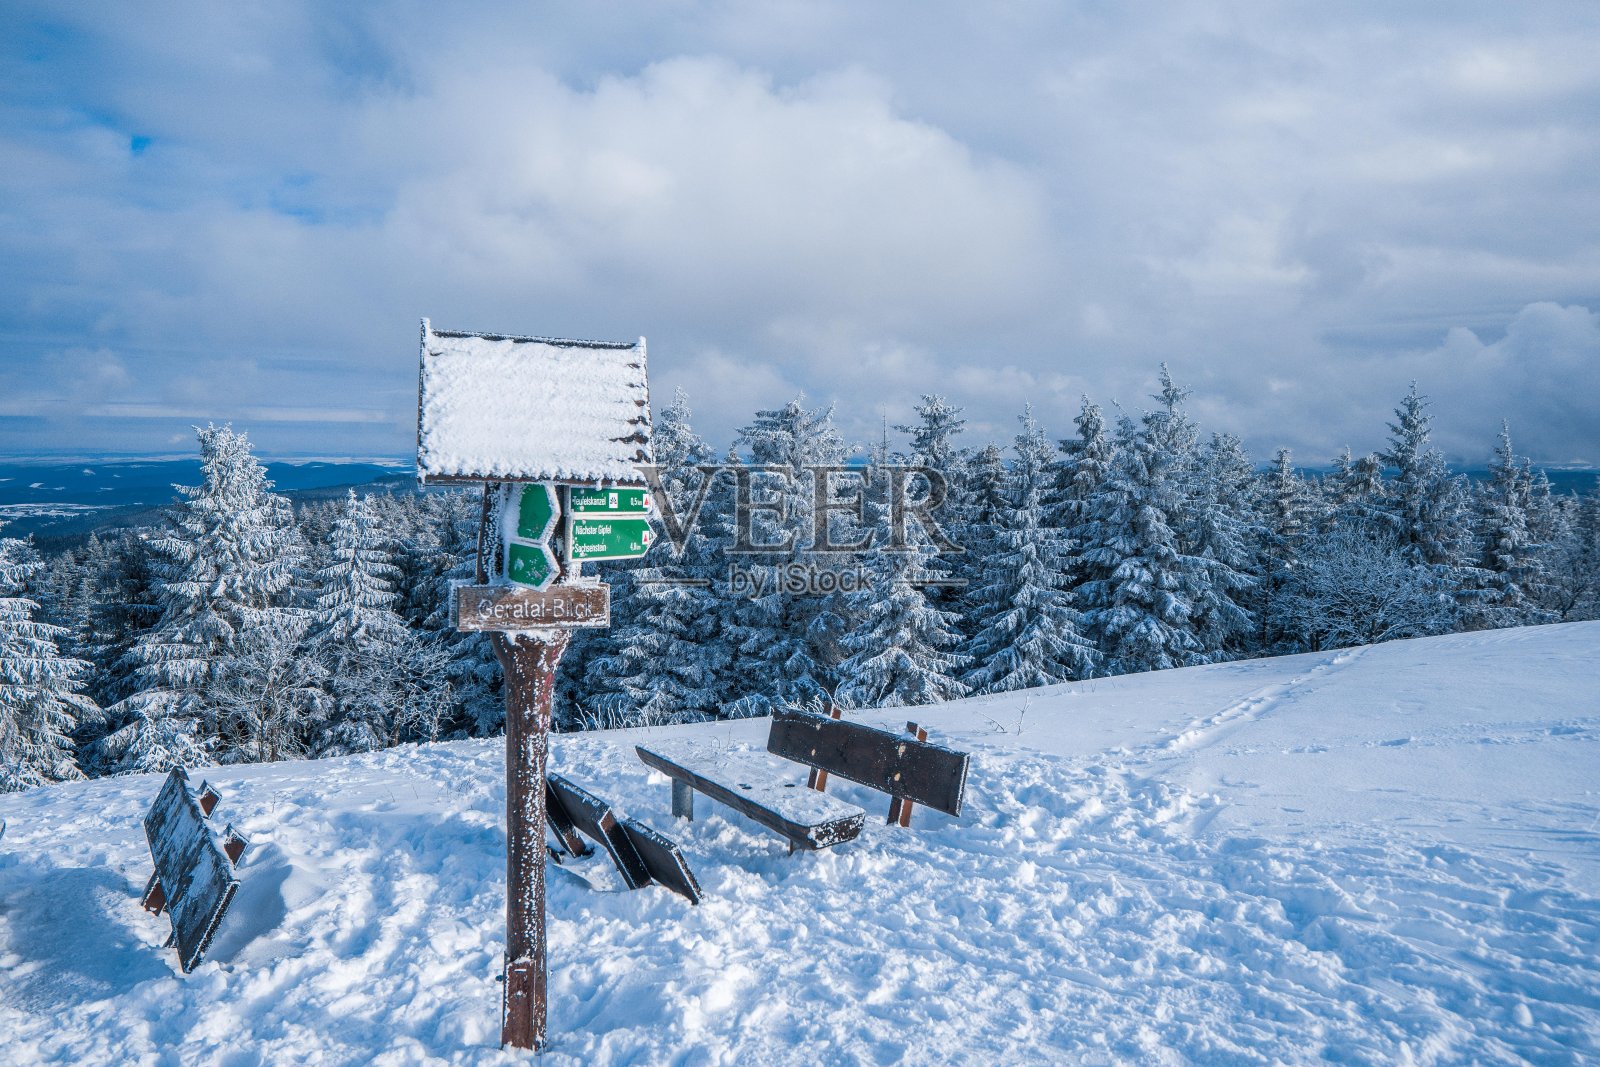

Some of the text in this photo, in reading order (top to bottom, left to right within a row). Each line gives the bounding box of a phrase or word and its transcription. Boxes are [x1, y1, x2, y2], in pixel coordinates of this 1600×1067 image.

[574, 496, 606, 506] Teufelskanzel
[575, 524, 612, 536] Nächster Gipfel
[574, 543, 607, 553] Sachsenstein
[478, 598, 593, 619] Geratal-Blick
